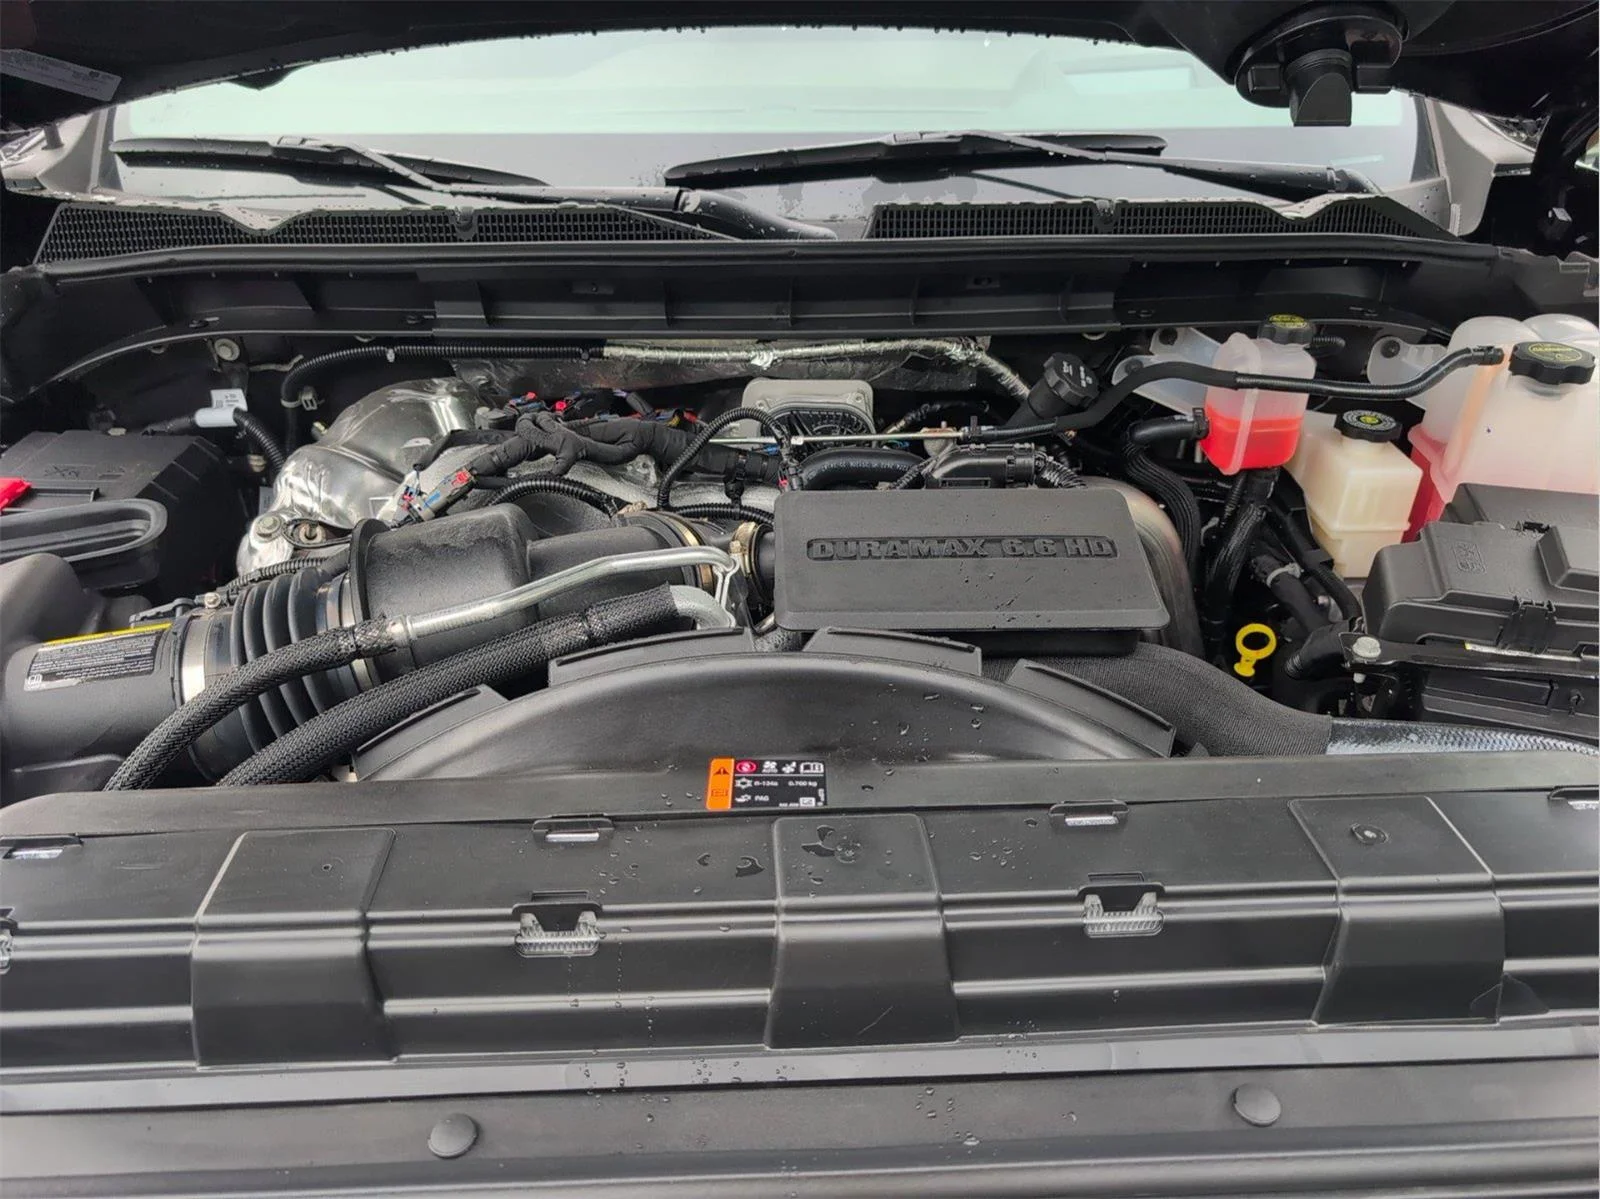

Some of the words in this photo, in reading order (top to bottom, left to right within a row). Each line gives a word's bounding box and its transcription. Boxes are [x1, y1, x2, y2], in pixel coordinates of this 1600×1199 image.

[811, 538, 988, 560] DURAMAX
[1001, 538, 1057, 557] 6.6
[1063, 537, 1113, 558] HD
